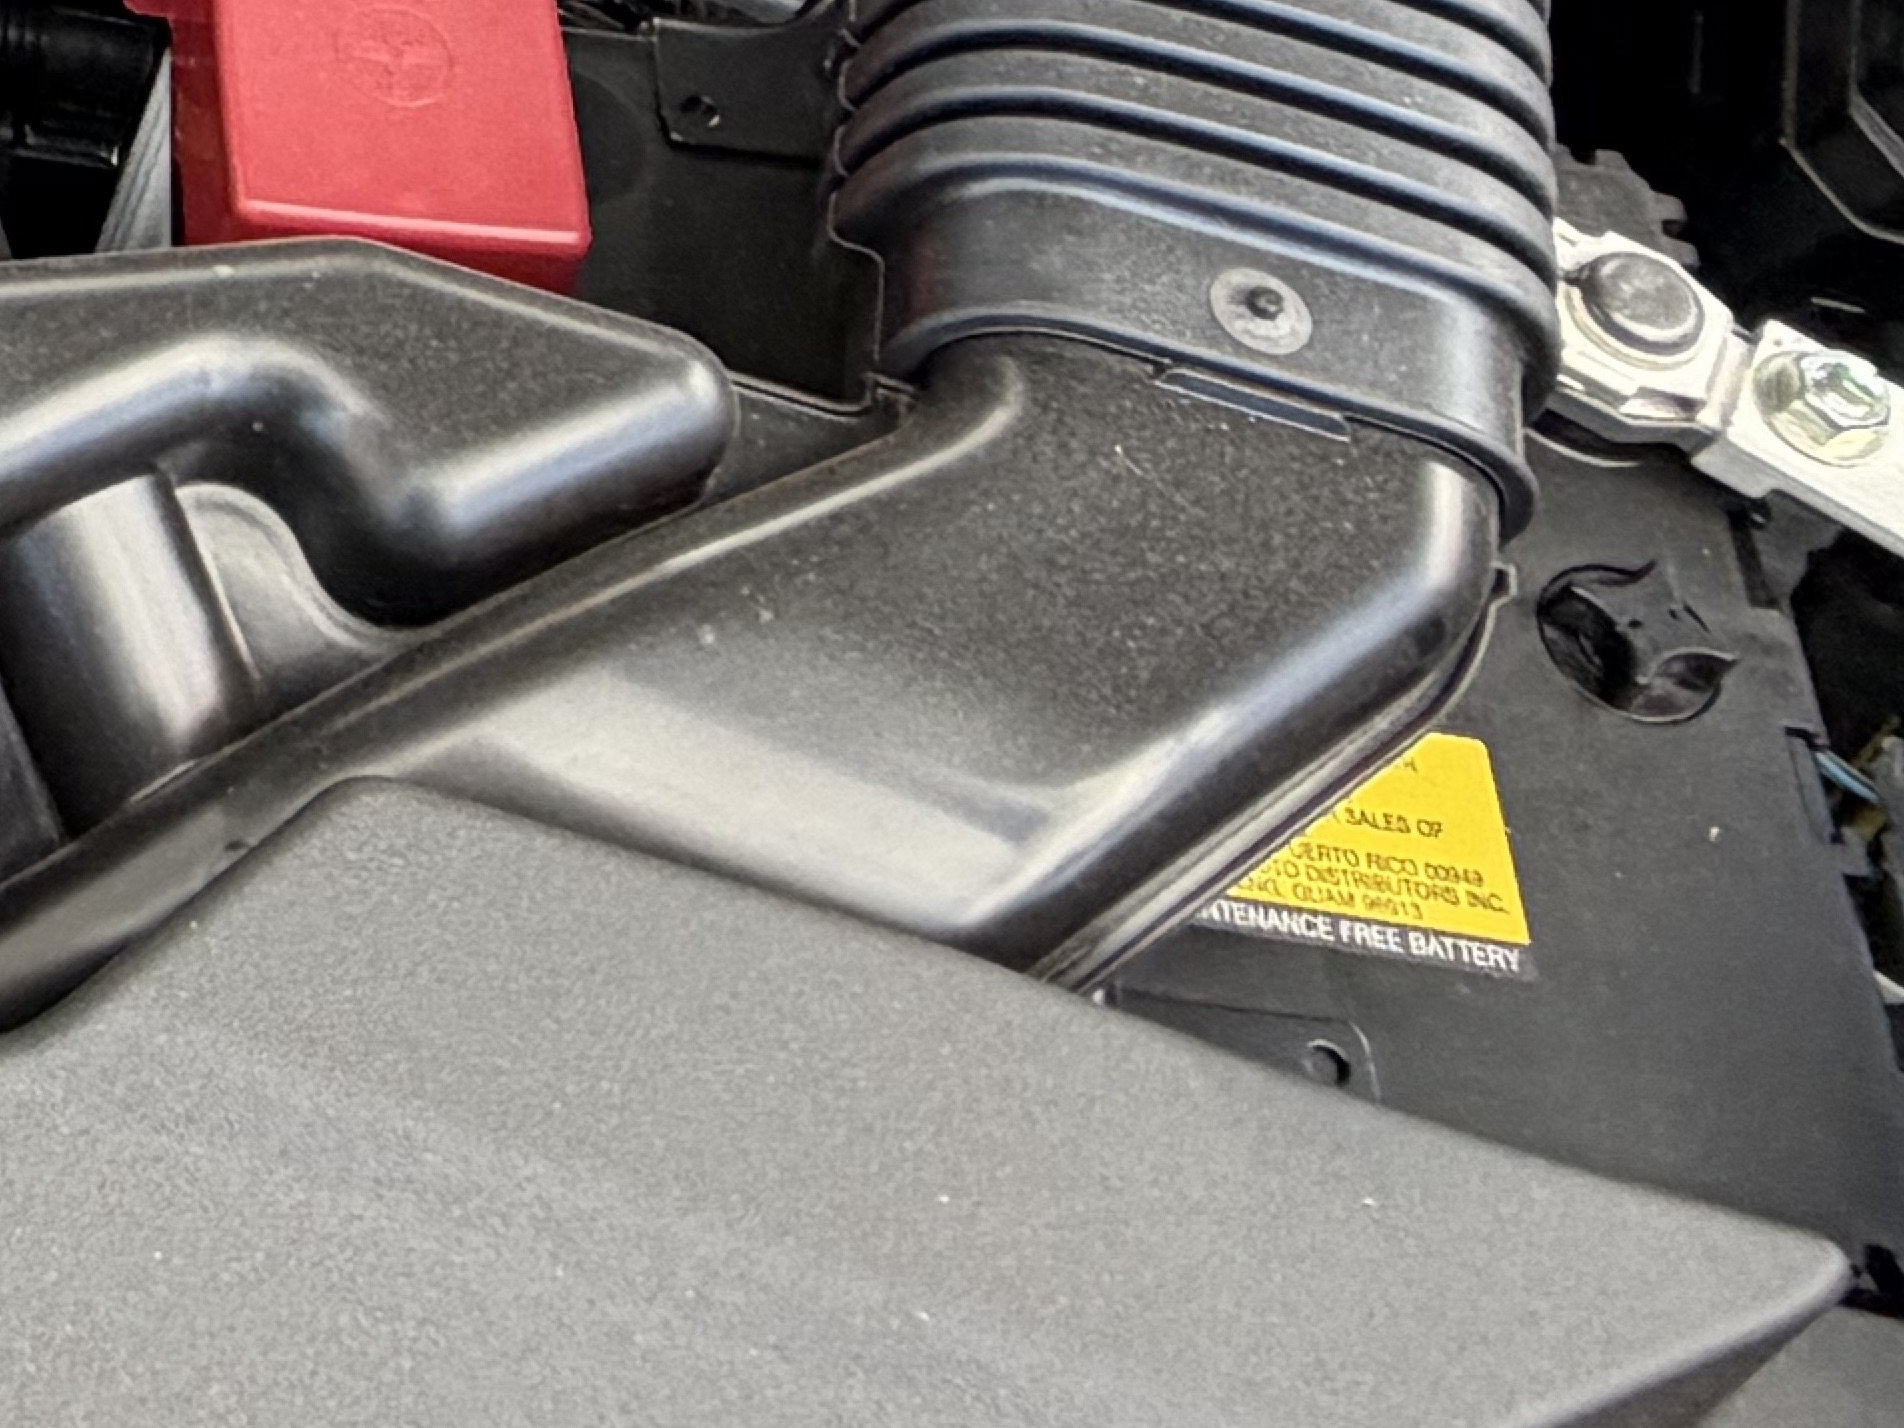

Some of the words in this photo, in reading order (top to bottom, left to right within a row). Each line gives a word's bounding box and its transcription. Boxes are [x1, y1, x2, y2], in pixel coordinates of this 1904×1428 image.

[1344, 806, 1411, 834] SALES
[1416, 818, 1444, 839] OF
[1290, 842, 1360, 867] UERTO
[1366, 852, 1419, 876] RICO
[1305, 863, 1460, 906] DISTRIBUTORS
[1338, 919, 1405, 954] FREE
[1408, 931, 1519, 972] BATTERY
